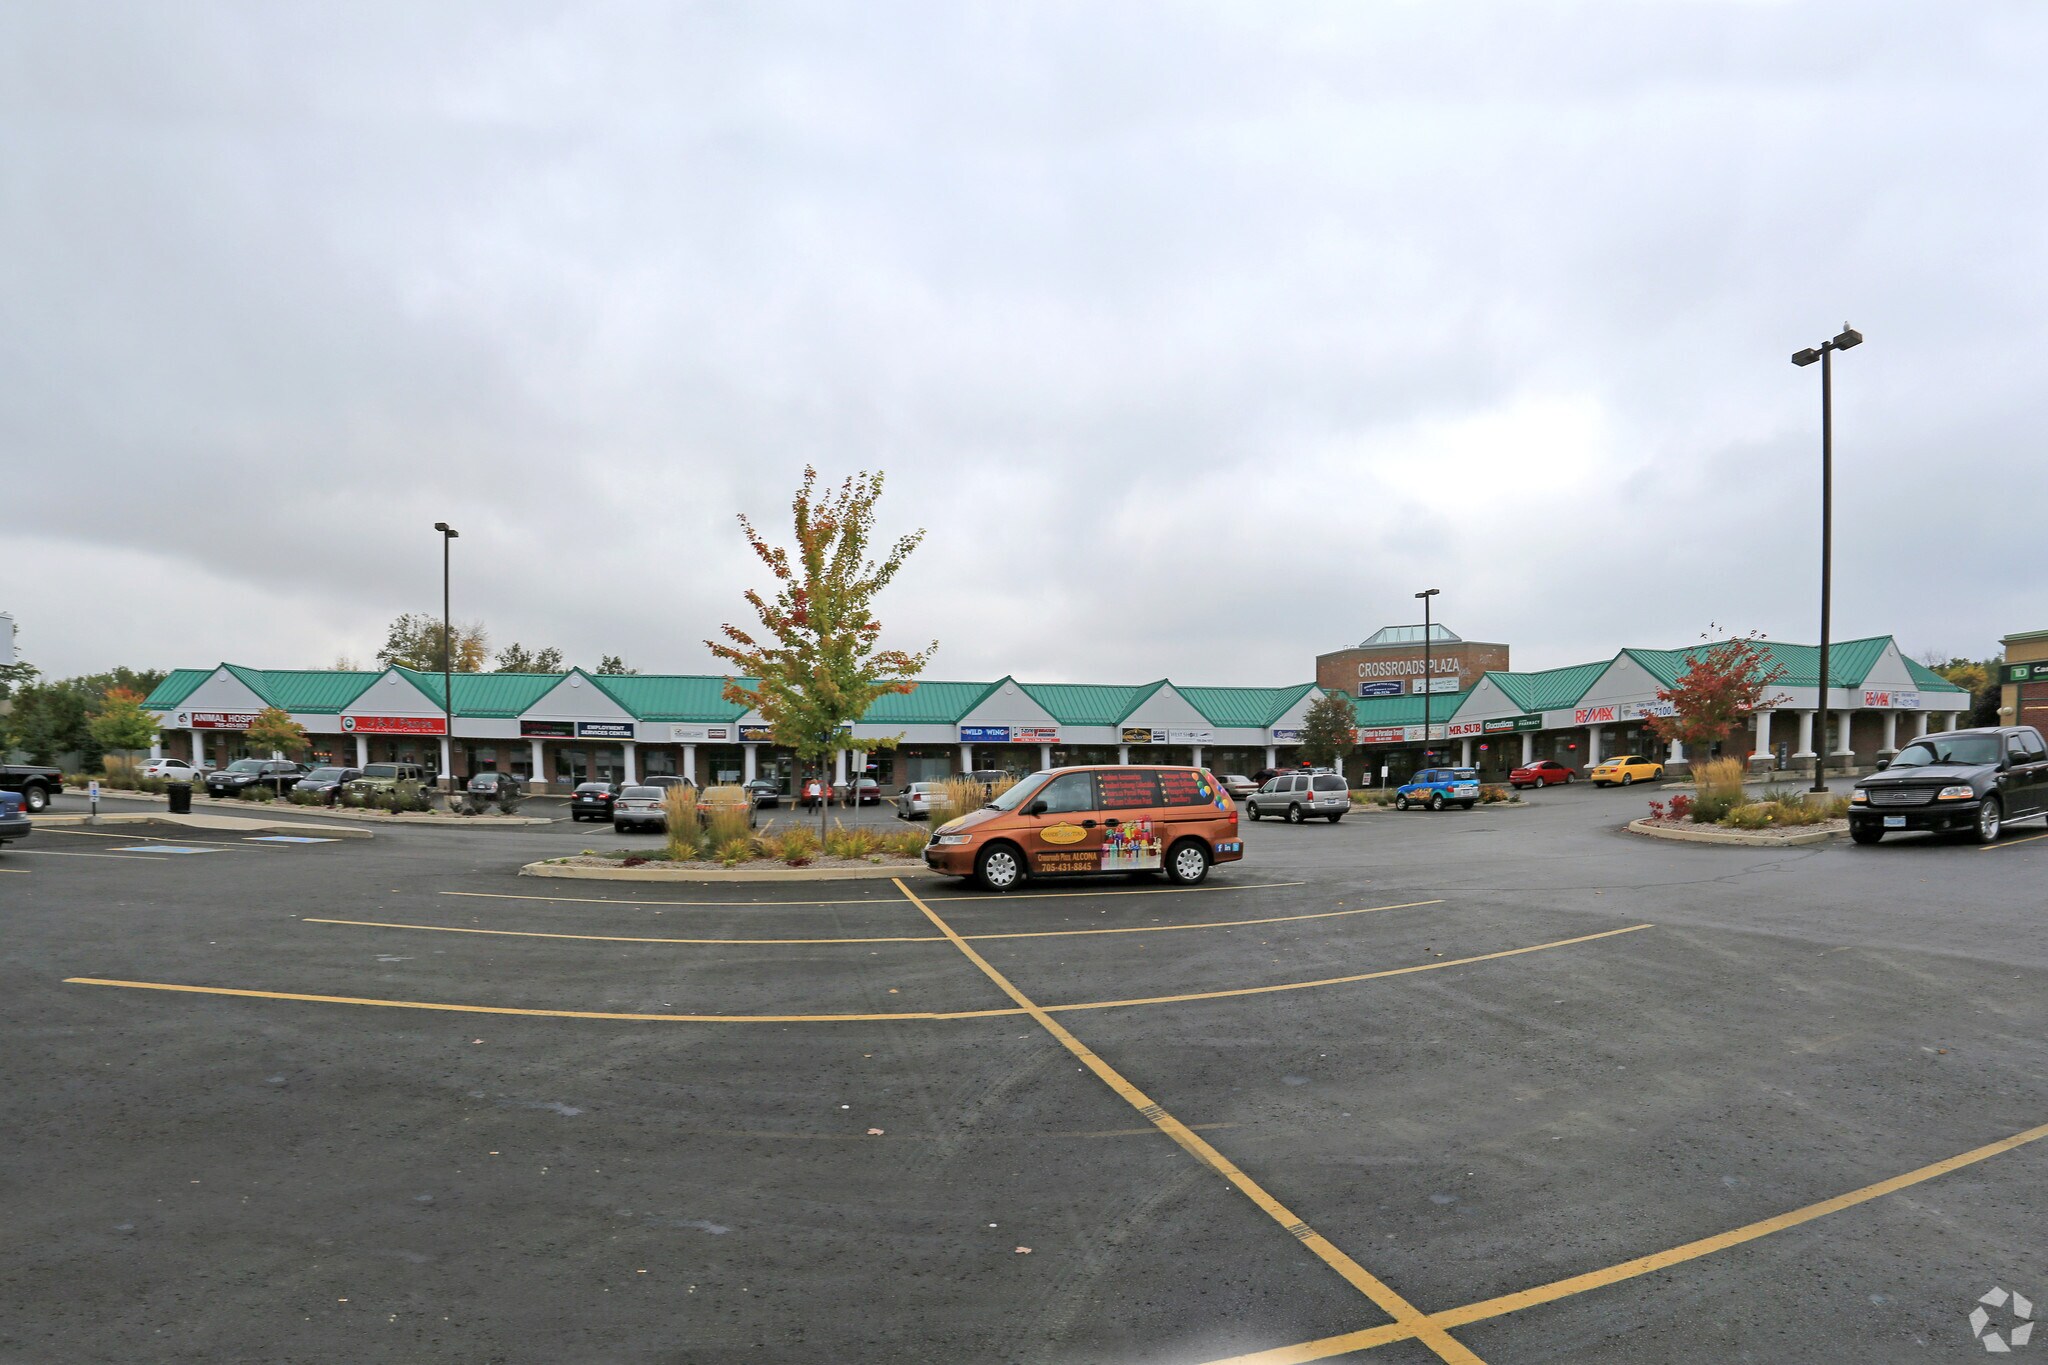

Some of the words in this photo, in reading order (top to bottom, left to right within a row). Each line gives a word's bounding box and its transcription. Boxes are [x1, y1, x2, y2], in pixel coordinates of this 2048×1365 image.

[1358, 660, 1425, 678] CROSSROADS
[1428, 657, 1460, 674] PLAZA
[1866, 691, 1889, 706] RE/MAX
[194, 713, 227, 722] ANIMAL
[1575, 706, 1614, 723] RE/MAX
[1485, 721, 1514, 730] Guardian
[1072, 852, 1097, 860] ALCONA
[1041, 863, 1092, 872] 705-431-8845
